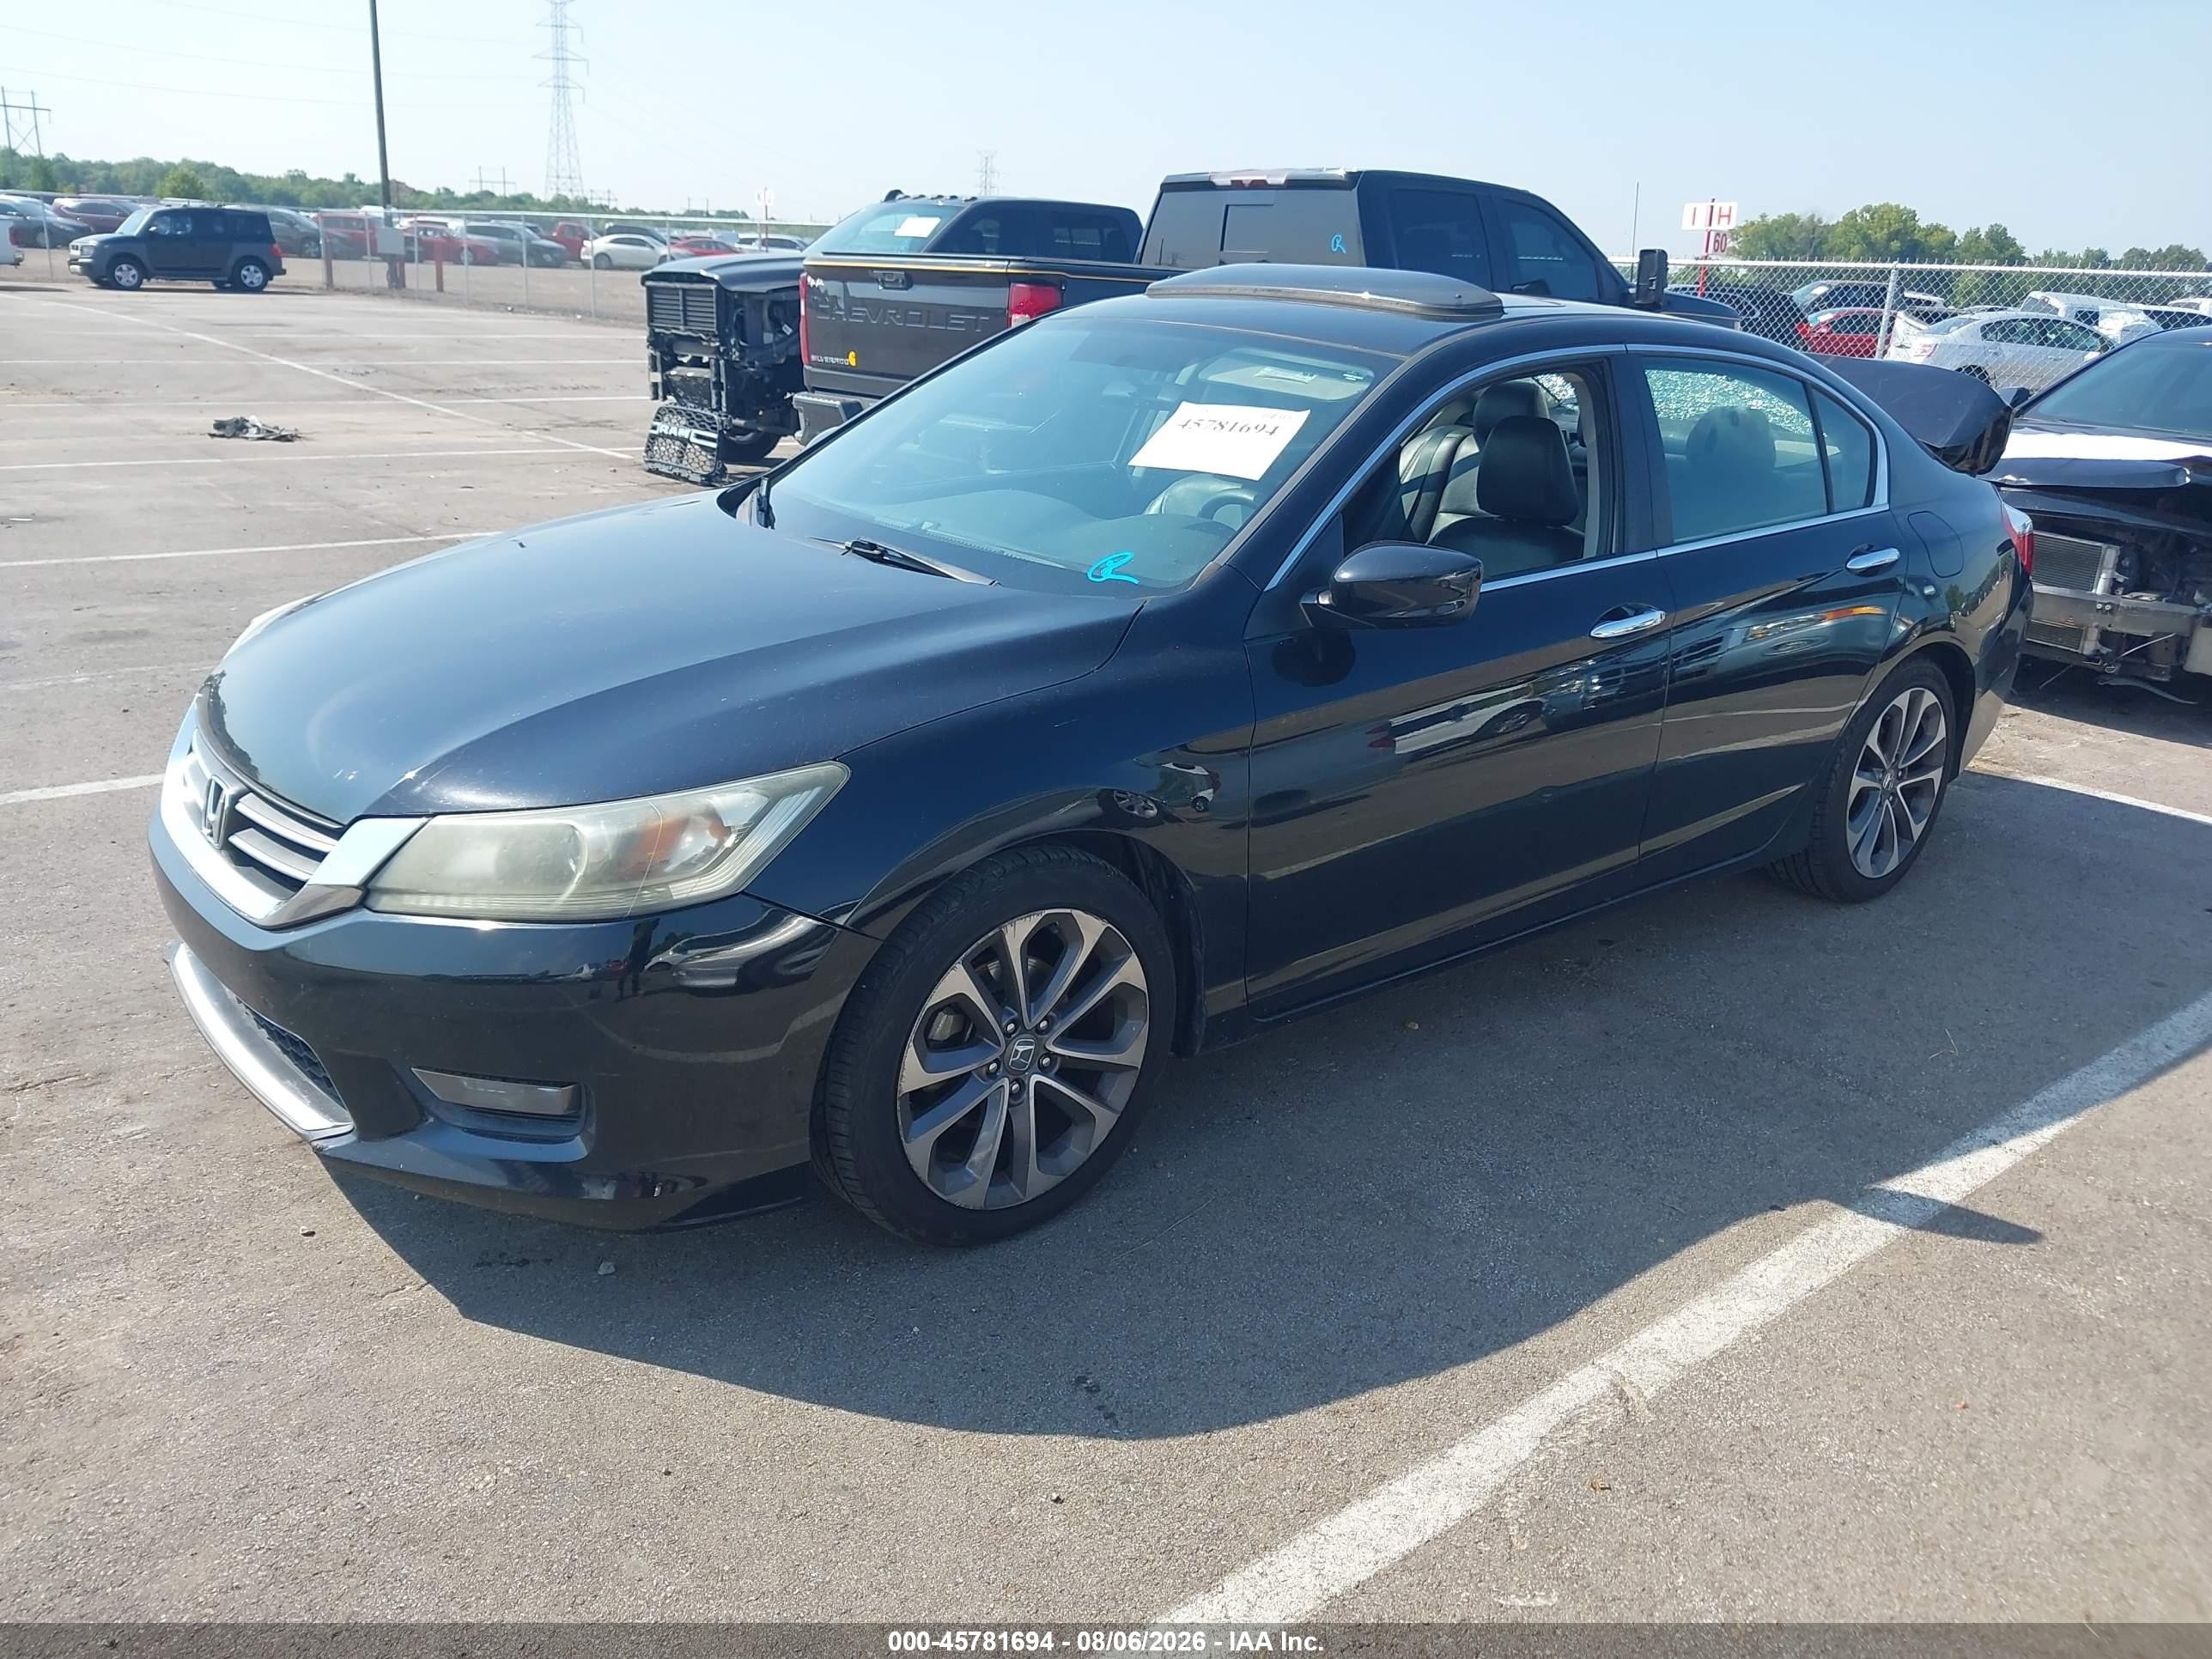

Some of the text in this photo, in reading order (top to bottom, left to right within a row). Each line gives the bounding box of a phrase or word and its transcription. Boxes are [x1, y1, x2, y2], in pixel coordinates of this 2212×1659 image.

[1717, 206, 1732, 225] H
[1713, 233, 1728, 252] 60
[817, 303, 990, 332] CHEVROLET
[658, 424, 690, 439] RAM
[1177, 418, 1279, 436] 45781694
